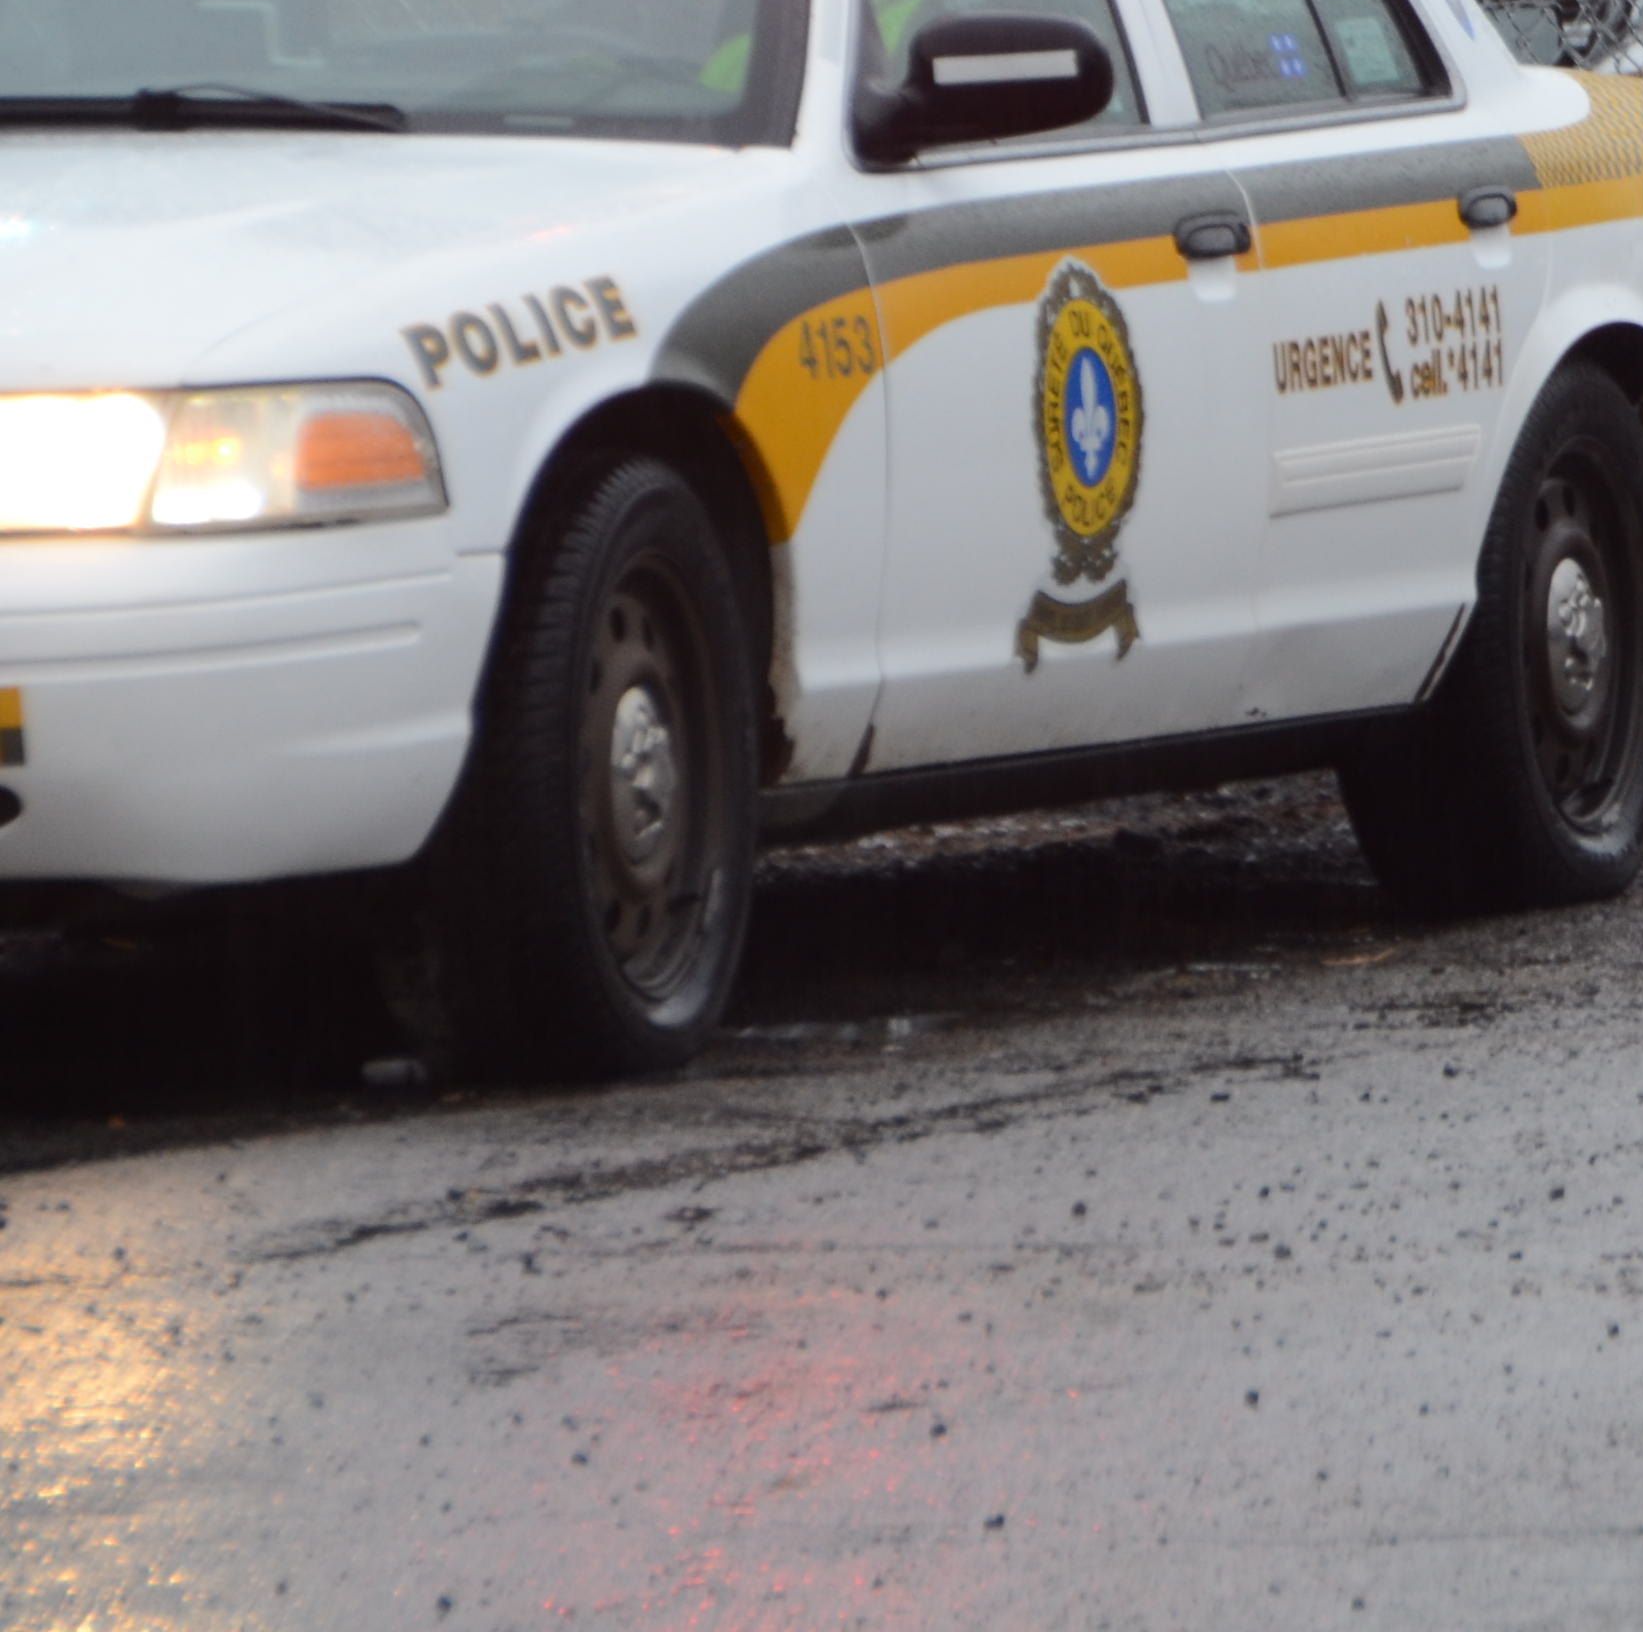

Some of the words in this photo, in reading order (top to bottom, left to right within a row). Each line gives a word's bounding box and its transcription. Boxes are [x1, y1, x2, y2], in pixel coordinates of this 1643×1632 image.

[401, 274, 638, 389] POLICE
[798, 314, 876, 381] 4153
[1069, 309, 1091, 339] DU
[1405, 283, 1502, 348] 310-4141
[1272, 328, 1374, 397] URGENCE
